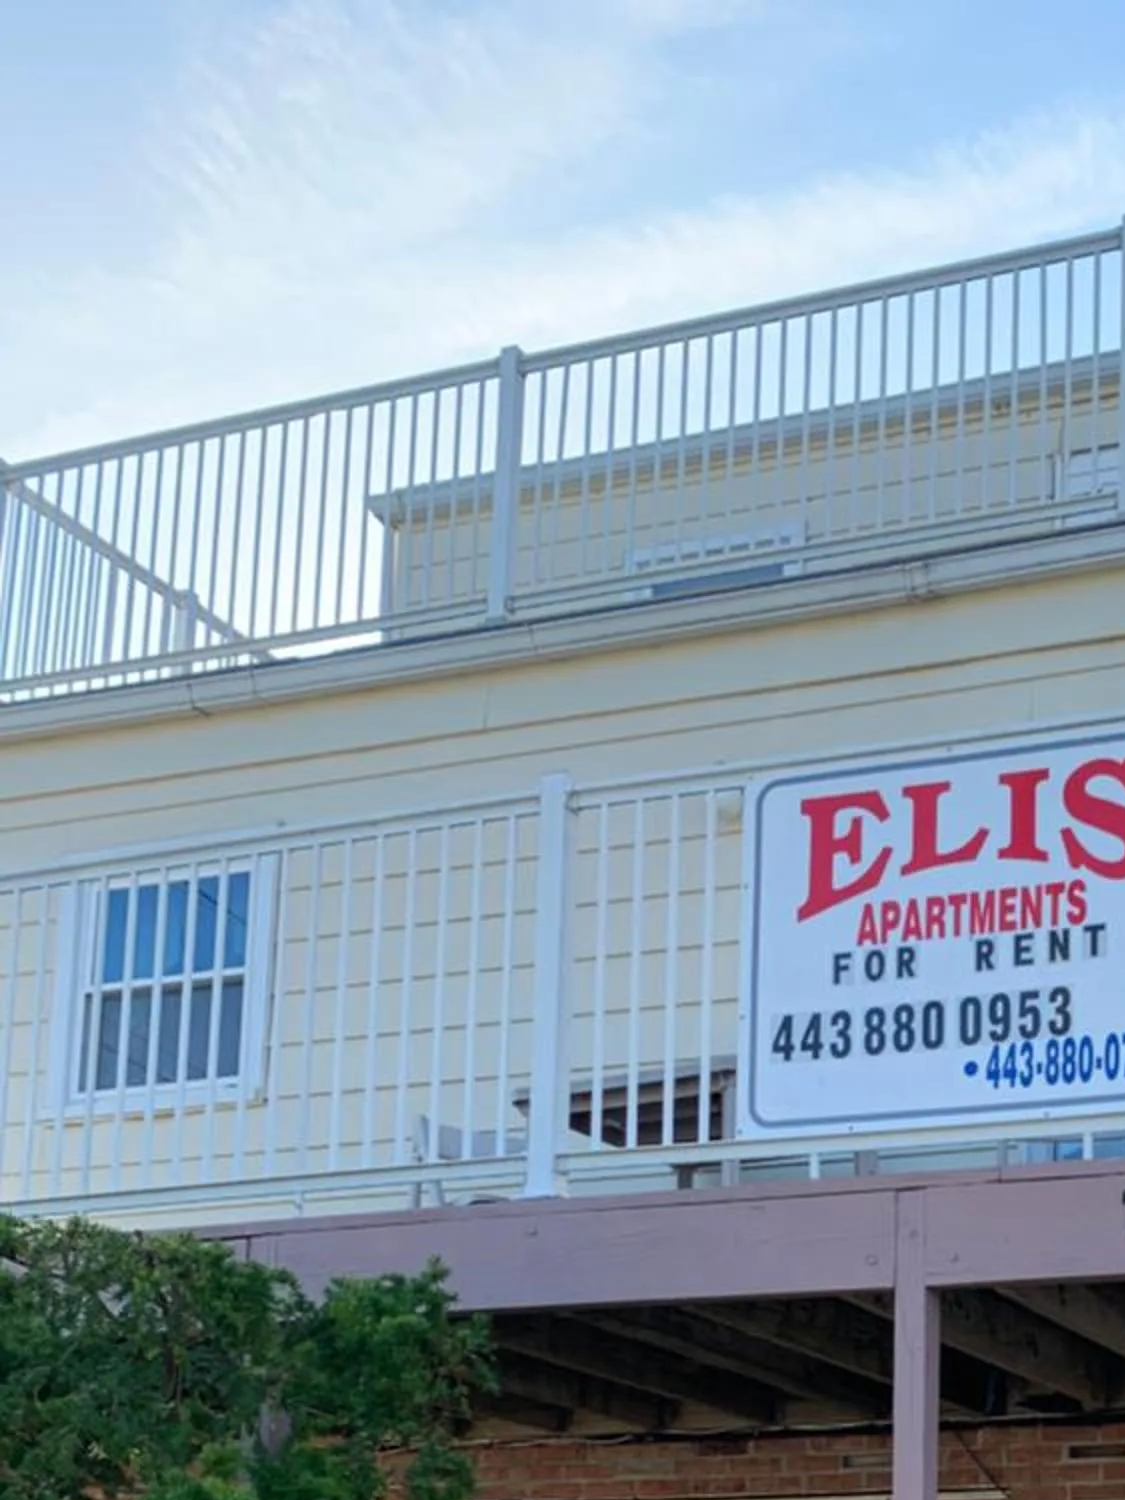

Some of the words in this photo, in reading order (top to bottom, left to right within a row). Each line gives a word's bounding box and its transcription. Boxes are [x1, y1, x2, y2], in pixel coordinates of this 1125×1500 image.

[857, 879, 1088, 946] APARTMENTS
[833, 947, 917, 985] FOR
[975, 924, 1106, 972] RENT
